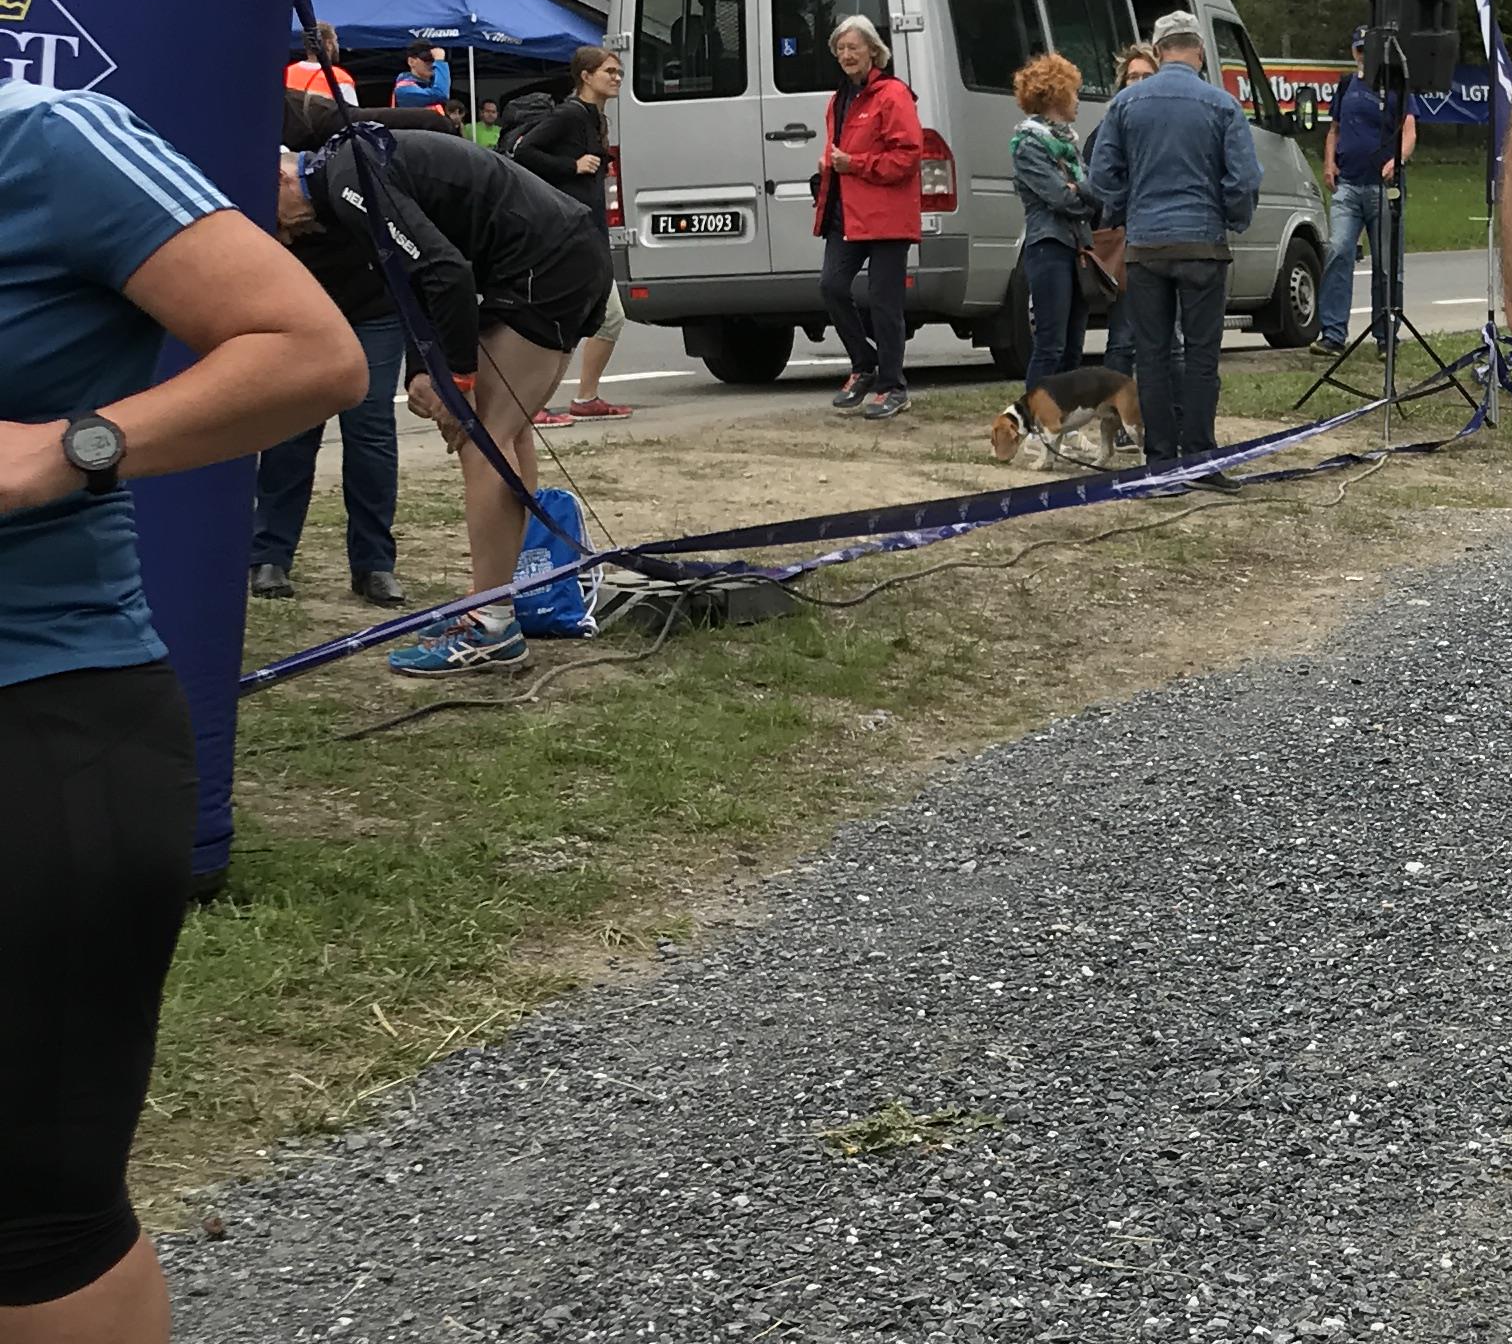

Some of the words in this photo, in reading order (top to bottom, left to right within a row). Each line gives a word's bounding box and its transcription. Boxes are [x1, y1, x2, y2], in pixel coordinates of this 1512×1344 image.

[1461, 85, 1490, 102] LGT
[659, 216, 676, 233] FL
[691, 214, 732, 232] 37093
